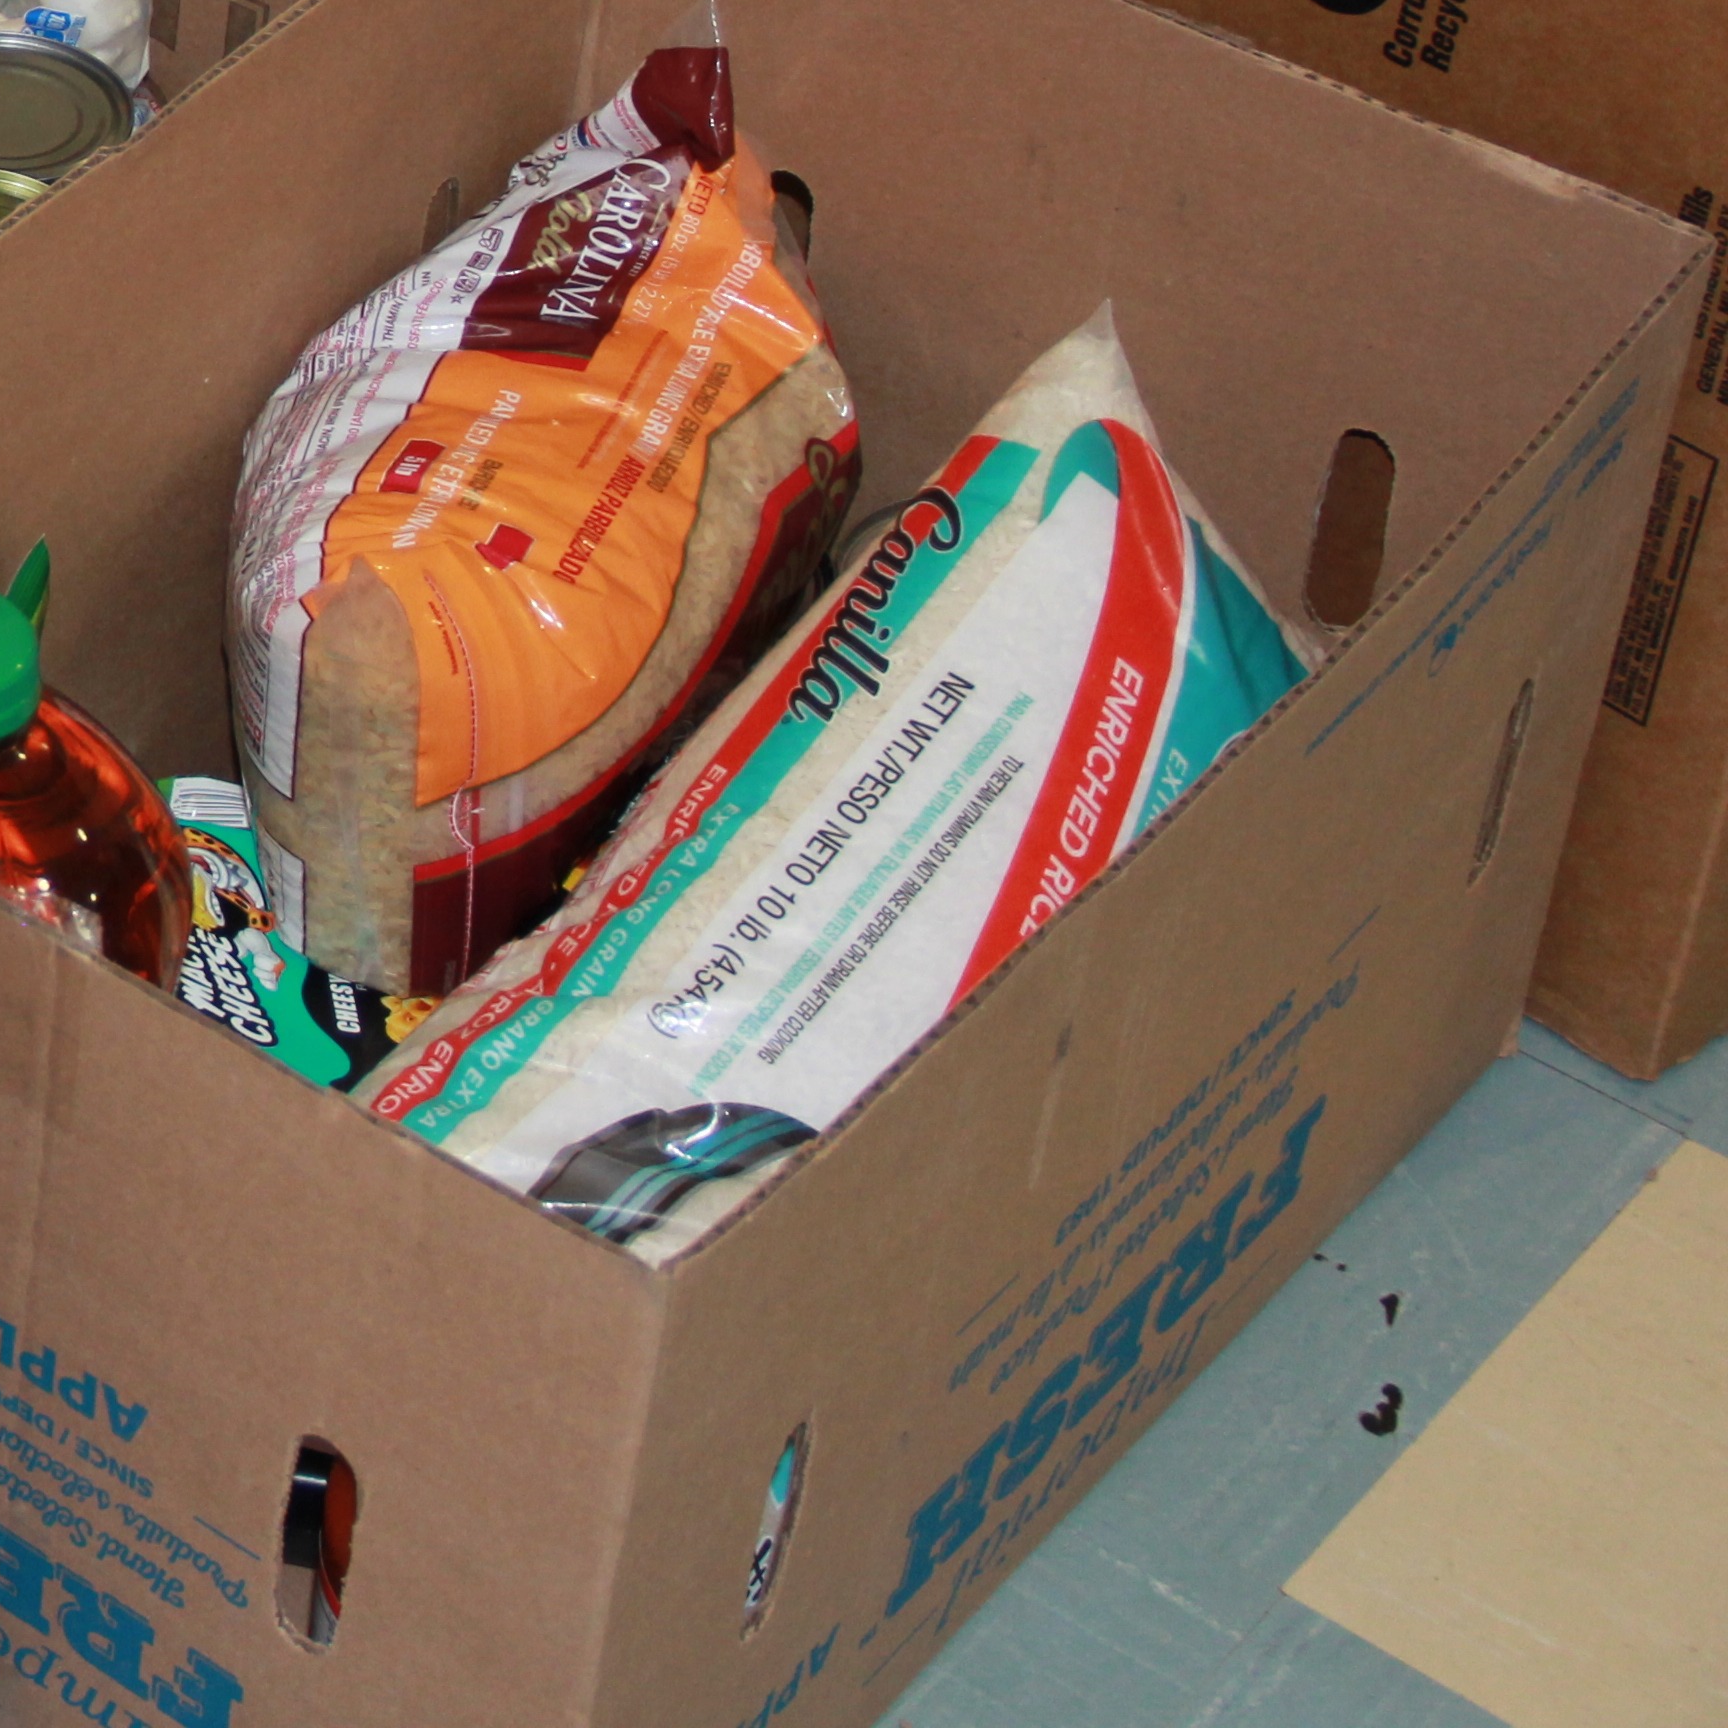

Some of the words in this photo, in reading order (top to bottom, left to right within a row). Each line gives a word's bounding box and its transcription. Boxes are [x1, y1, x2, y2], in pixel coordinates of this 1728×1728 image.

[540, 158, 673, 322] CAROLINA
[786, 485, 963, 726] Canilla
[921, 671, 975, 725] NET
[836, 717, 940, 825] WT./PESO
[1053, 654, 1146, 867] ENRICHED
[785, 817, 853, 887] NETO
[727, 917, 772, 943] lb.
[756, 884, 798, 920] 10
[208, 930, 275, 1045] CHEESE
[329, 972, 362, 1035] CHEESY
[75, 1438, 154, 1500] SINCE
[96, 1530, 186, 1610] Hand
[116, 1502, 249, 1609] Produits
